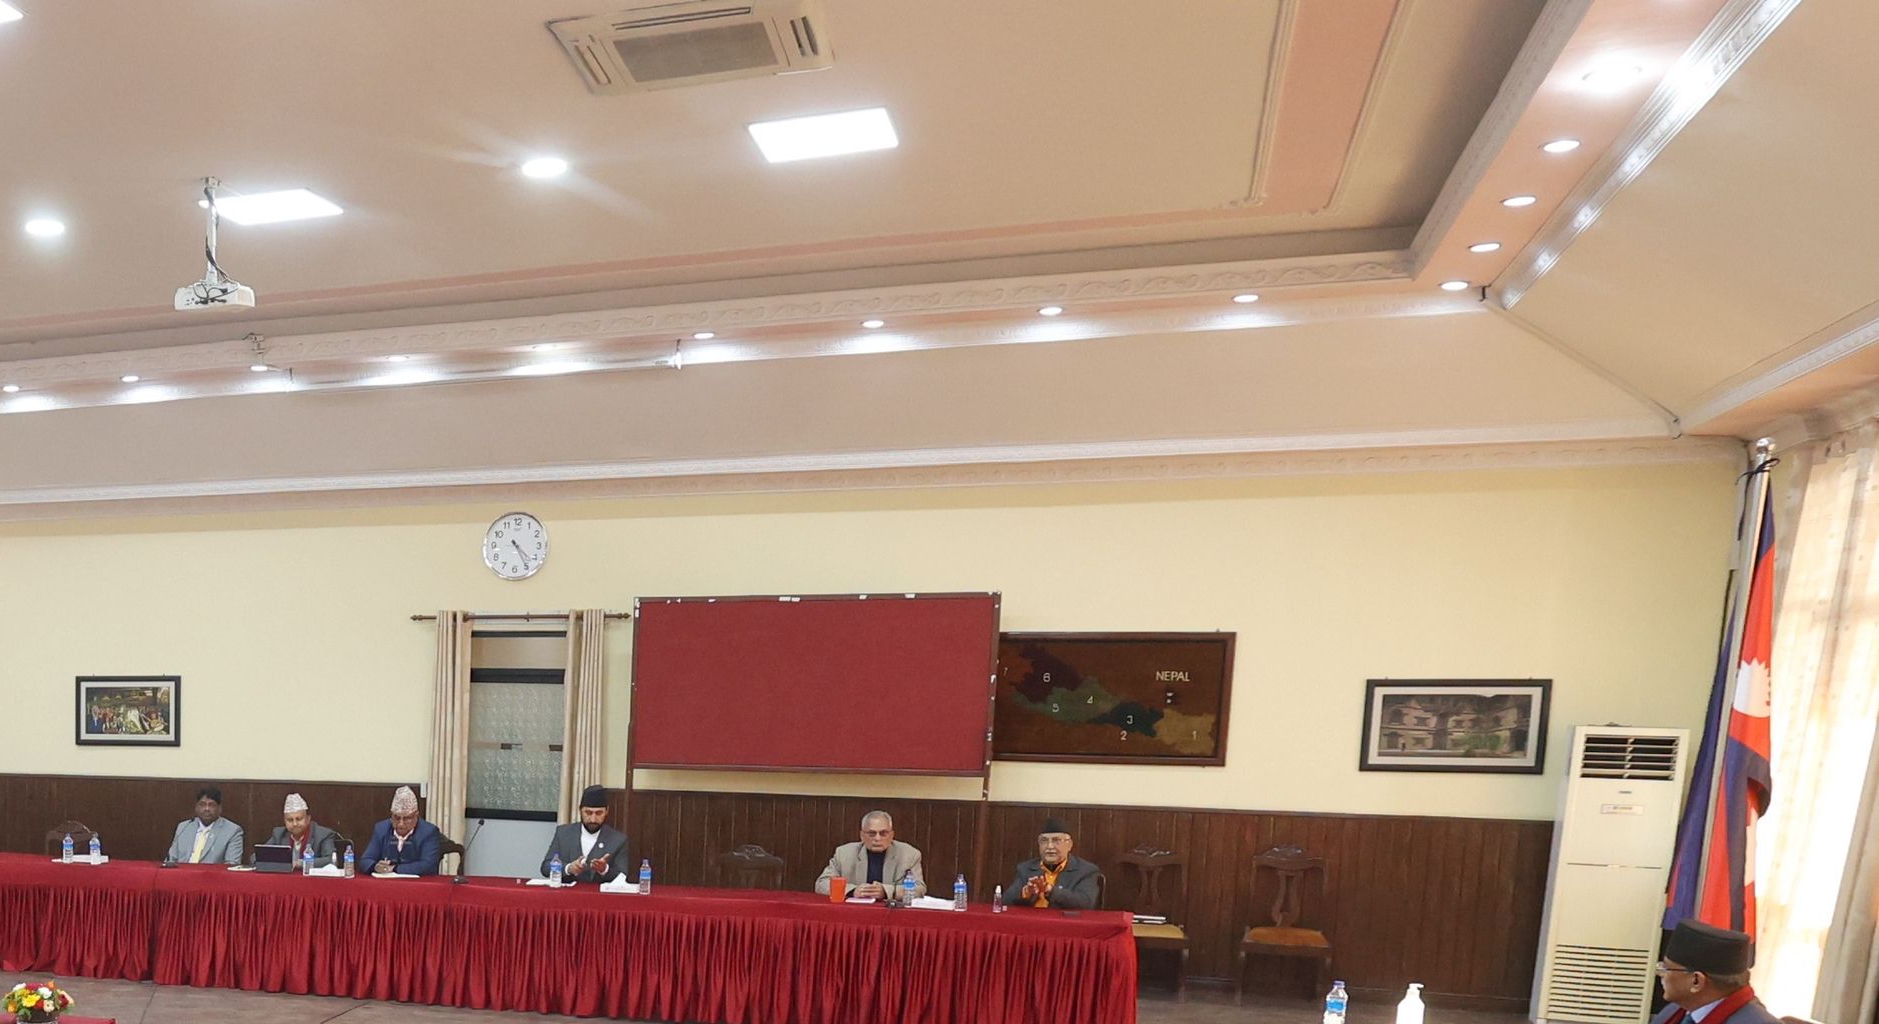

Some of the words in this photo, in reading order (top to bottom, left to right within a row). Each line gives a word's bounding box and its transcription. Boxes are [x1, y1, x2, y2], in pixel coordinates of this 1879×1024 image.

[513, 518, 522, 526] 12
[494, 553, 499, 561] 8
[524, 562, 529, 570] 5
[1043, 672, 1051, 683] 6
[1155, 670, 1191, 682] NEPAL
[1087, 696, 1094, 704] 4
[1052, 703, 1060, 712] 5
[1126, 715, 1134, 724] 3
[1120, 730, 1128, 740] 2
[1192, 730, 1197, 740] 1
